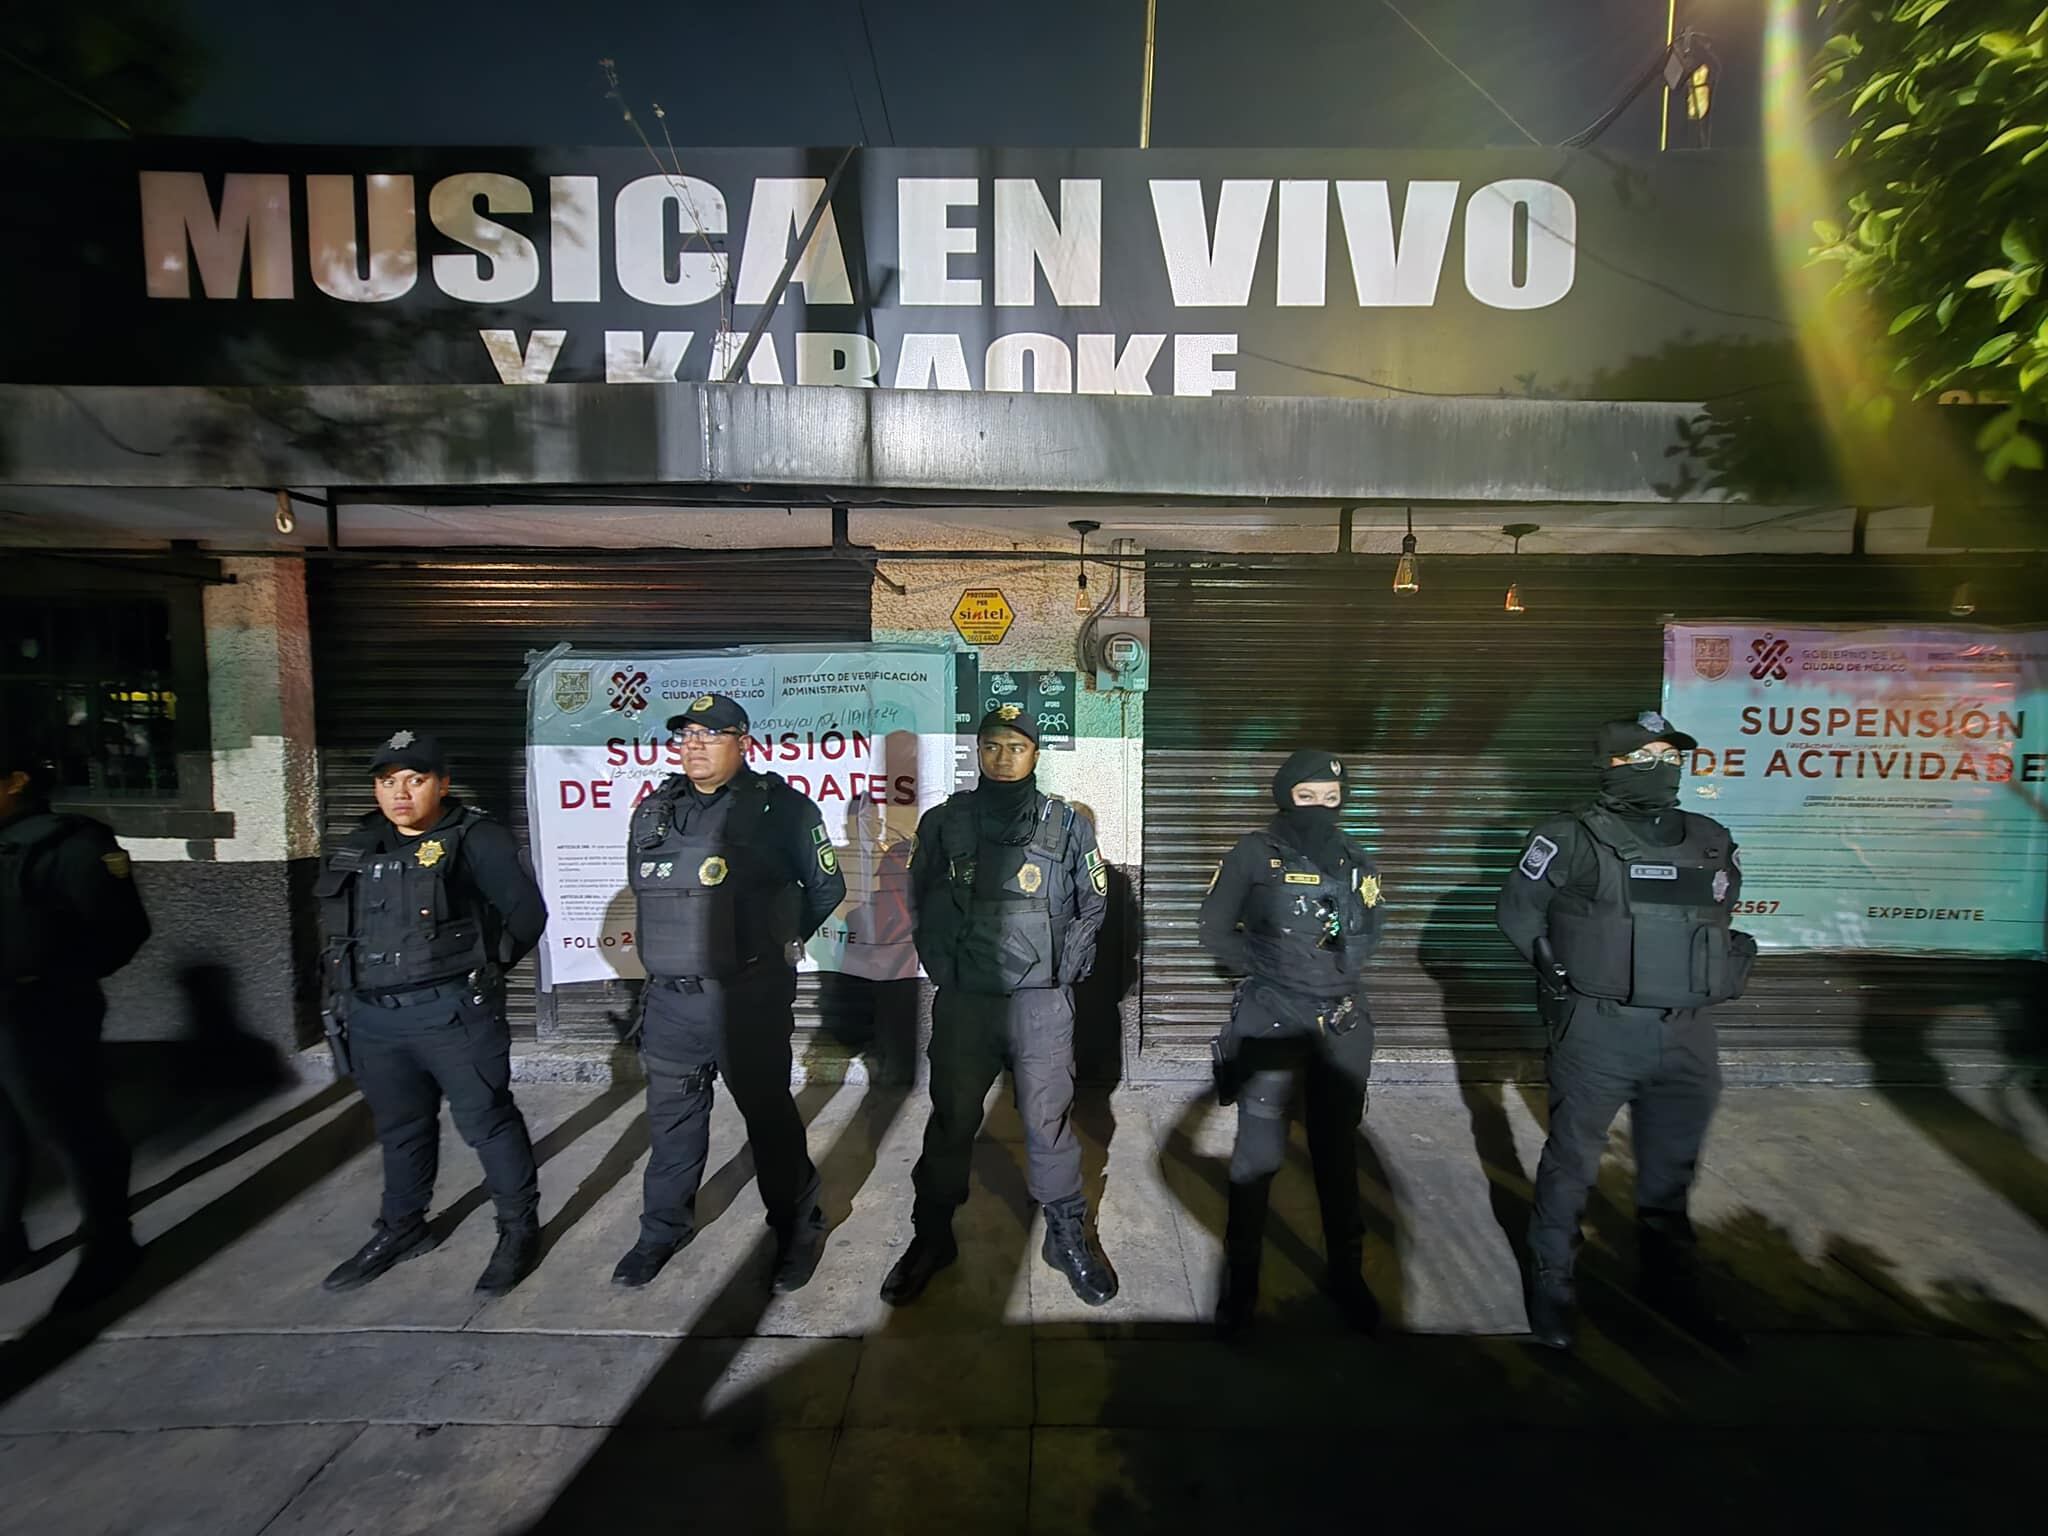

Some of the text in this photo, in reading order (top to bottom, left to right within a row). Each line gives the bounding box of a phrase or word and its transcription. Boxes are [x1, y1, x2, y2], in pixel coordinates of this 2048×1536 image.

[138, 170, 1576, 310] MUSICA EN VIVO
[479, 330, 567, 384] Y
[959, 608, 1003, 619] sintel
[1802, 663, 1844, 671] CIUDAD
[1847, 664, 1861, 672] DE
[661, 677, 765, 688] GOBIERNO DE LA
[782, 671, 928, 685] INSTITUTO DE VERIFICACIÓN
[662, 690, 704, 700] CIUDAD
[725, 688, 765, 699] MÉXICO
[781, 684, 867, 697] ADMINISTRATIVA
[1740, 703, 2025, 740] SUSPENSIÓN
[607, 724, 871, 766] SUSNSIÓN
[1690, 747, 1747, 777] DE
[560, 780, 613, 809] DE
[1733, 900, 1985, 922] 2567 EXPEDIENTE
[563, 936, 616, 949] FOLIO
